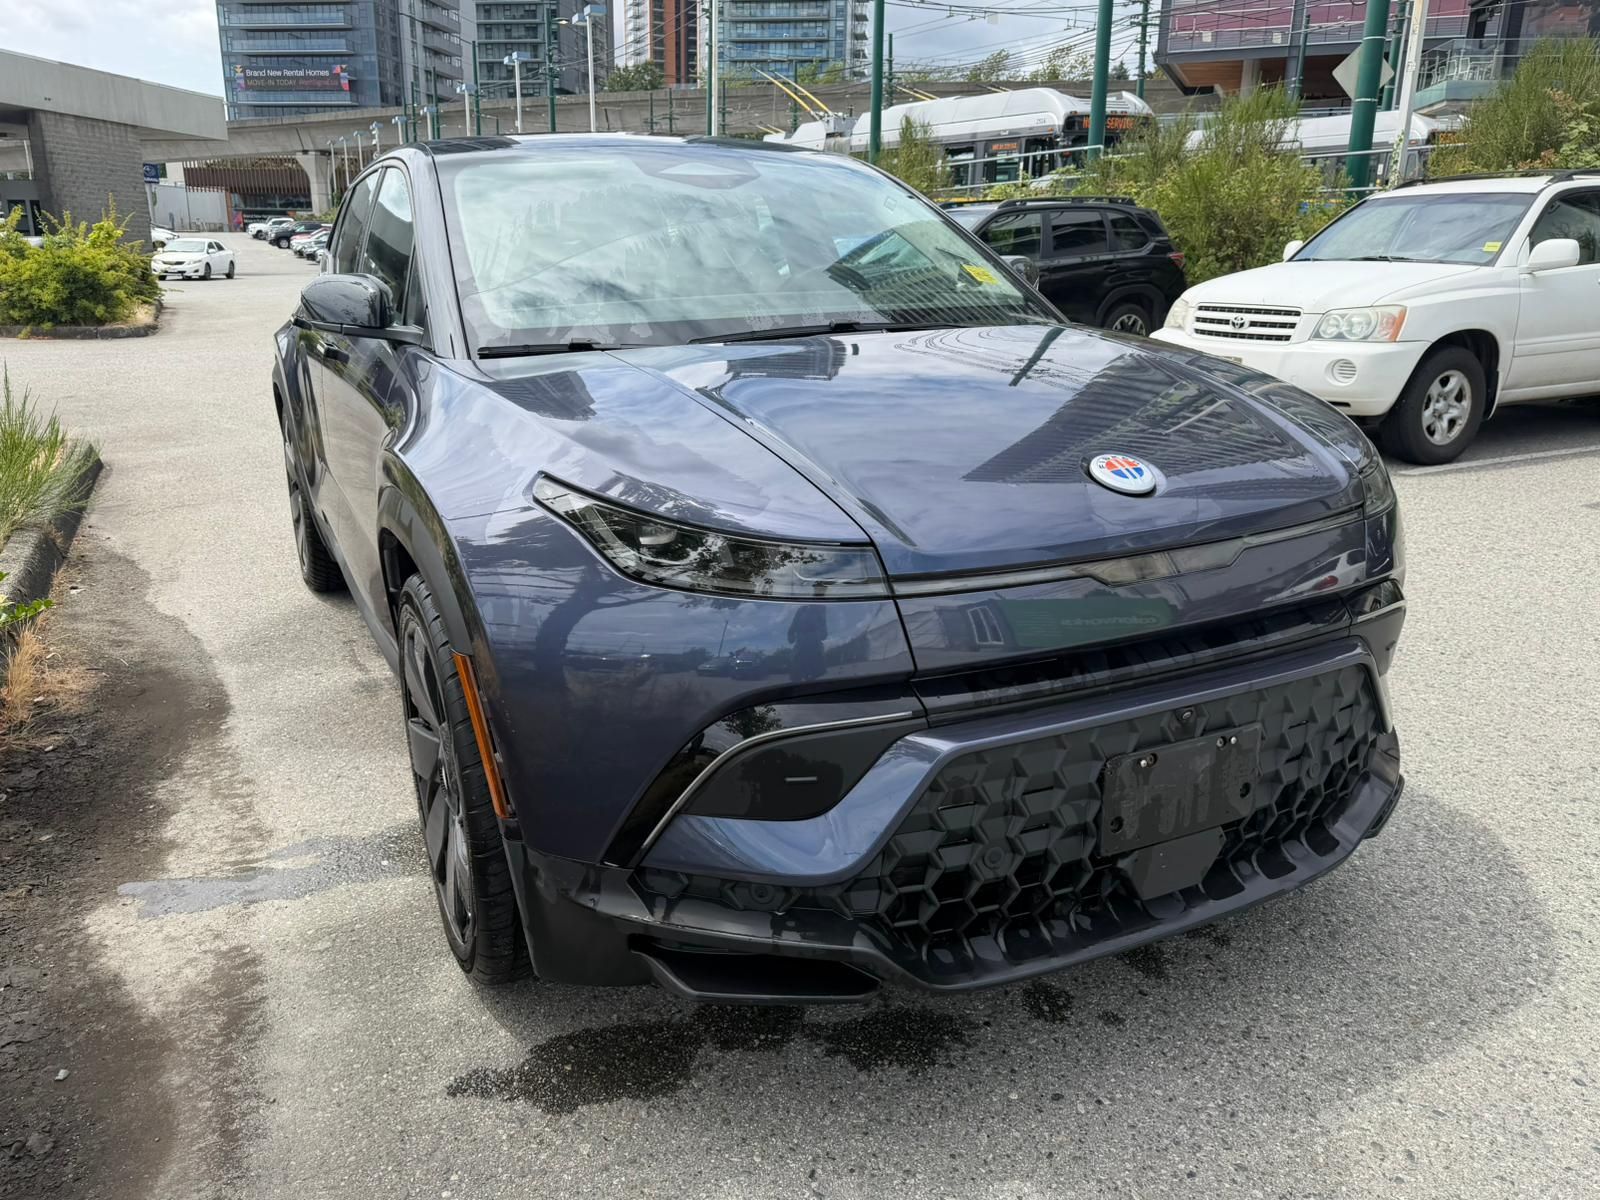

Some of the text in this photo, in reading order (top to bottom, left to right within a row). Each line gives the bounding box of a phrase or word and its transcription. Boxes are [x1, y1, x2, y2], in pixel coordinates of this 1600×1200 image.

[246, 69, 330, 77] Brand New Rental Homes
